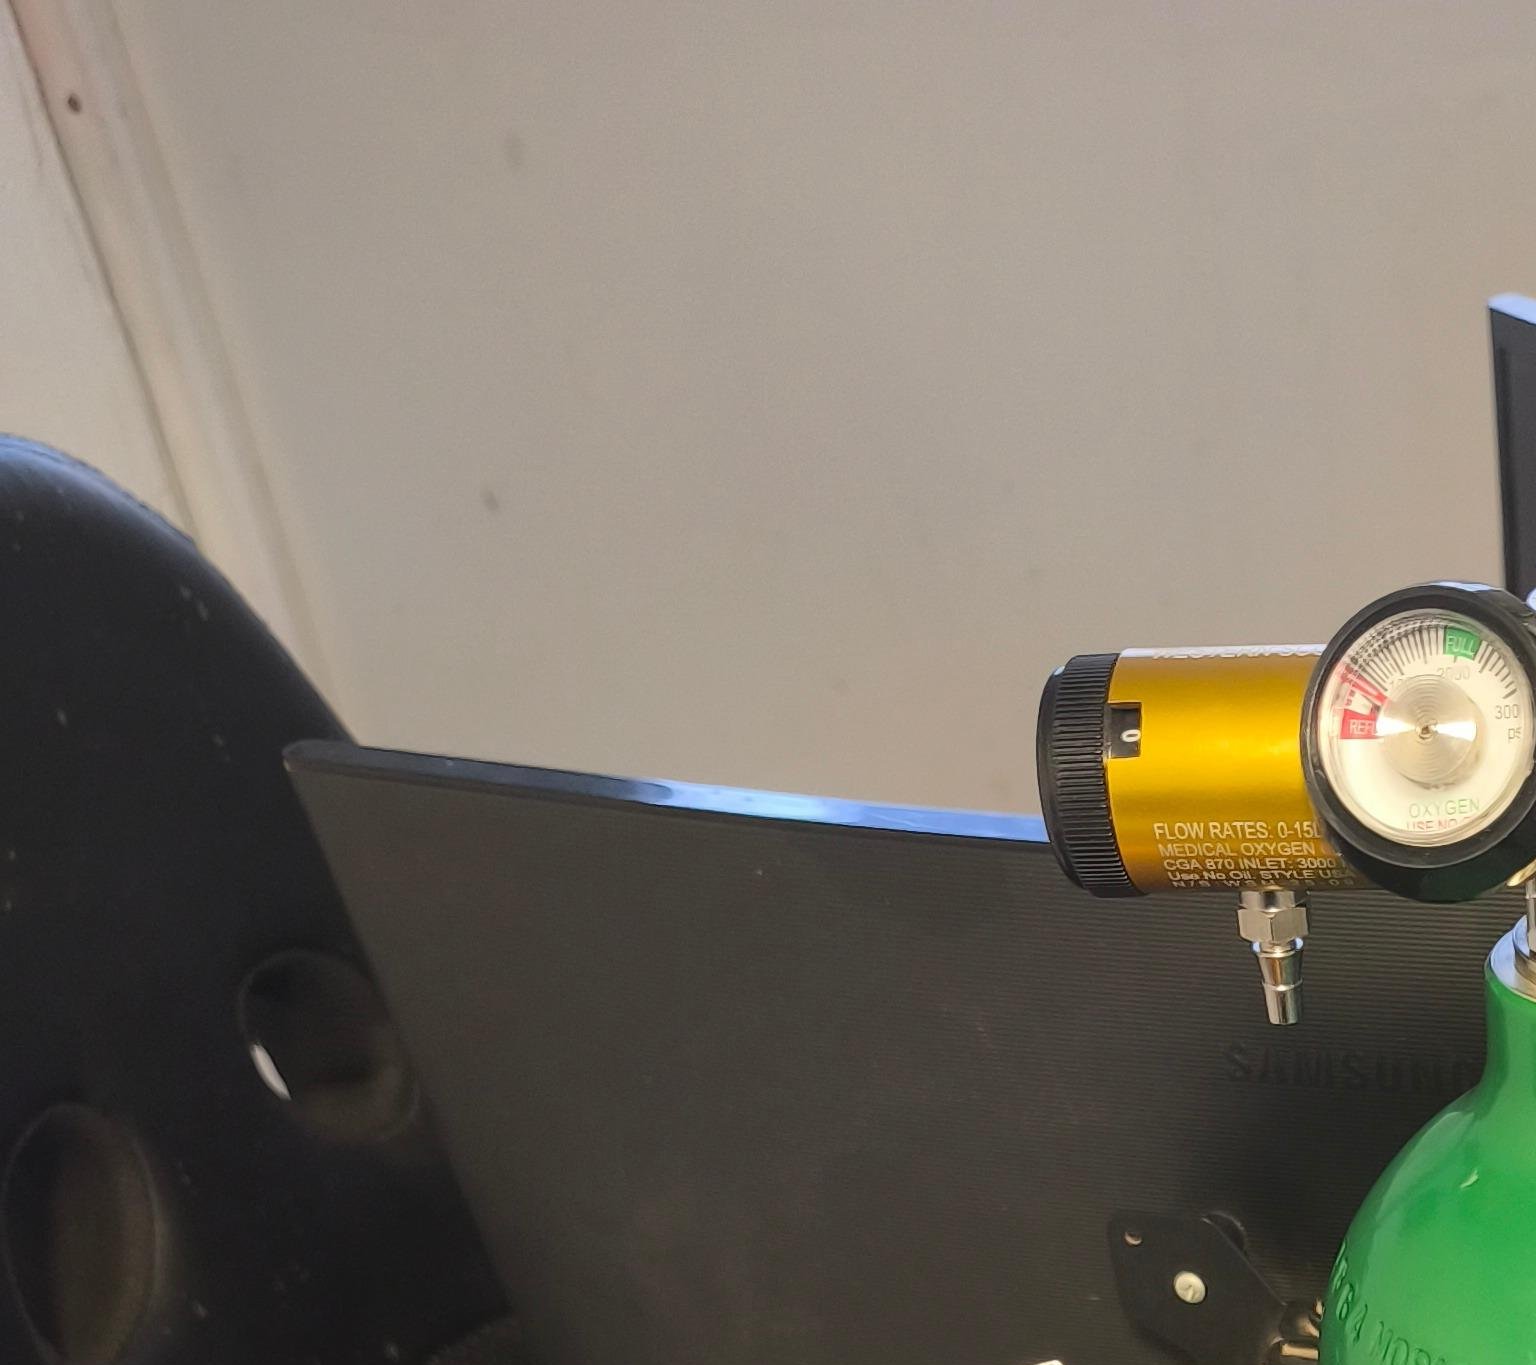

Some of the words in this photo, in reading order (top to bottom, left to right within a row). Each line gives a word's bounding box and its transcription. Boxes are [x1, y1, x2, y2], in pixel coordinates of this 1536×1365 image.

[1408, 799, 1481, 819] OXYGEN
[1153, 822, 1204, 840] FLOW
[1210, 821, 1273, 840] RATES:
[1157, 842, 1238, 858] MEDICAL
[1240, 841, 1316, 857] OXYGEN
[1163, 858, 1202, 871] CGA
[1206, 858, 1235, 871] 870
[1239, 857, 1294, 870] INLET:
[1296, 857, 1336, 870] 3000
[1167, 871, 1198, 881] Use
[1204, 871, 1227, 881] No
[1261, 870, 1316, 880] STYLE
